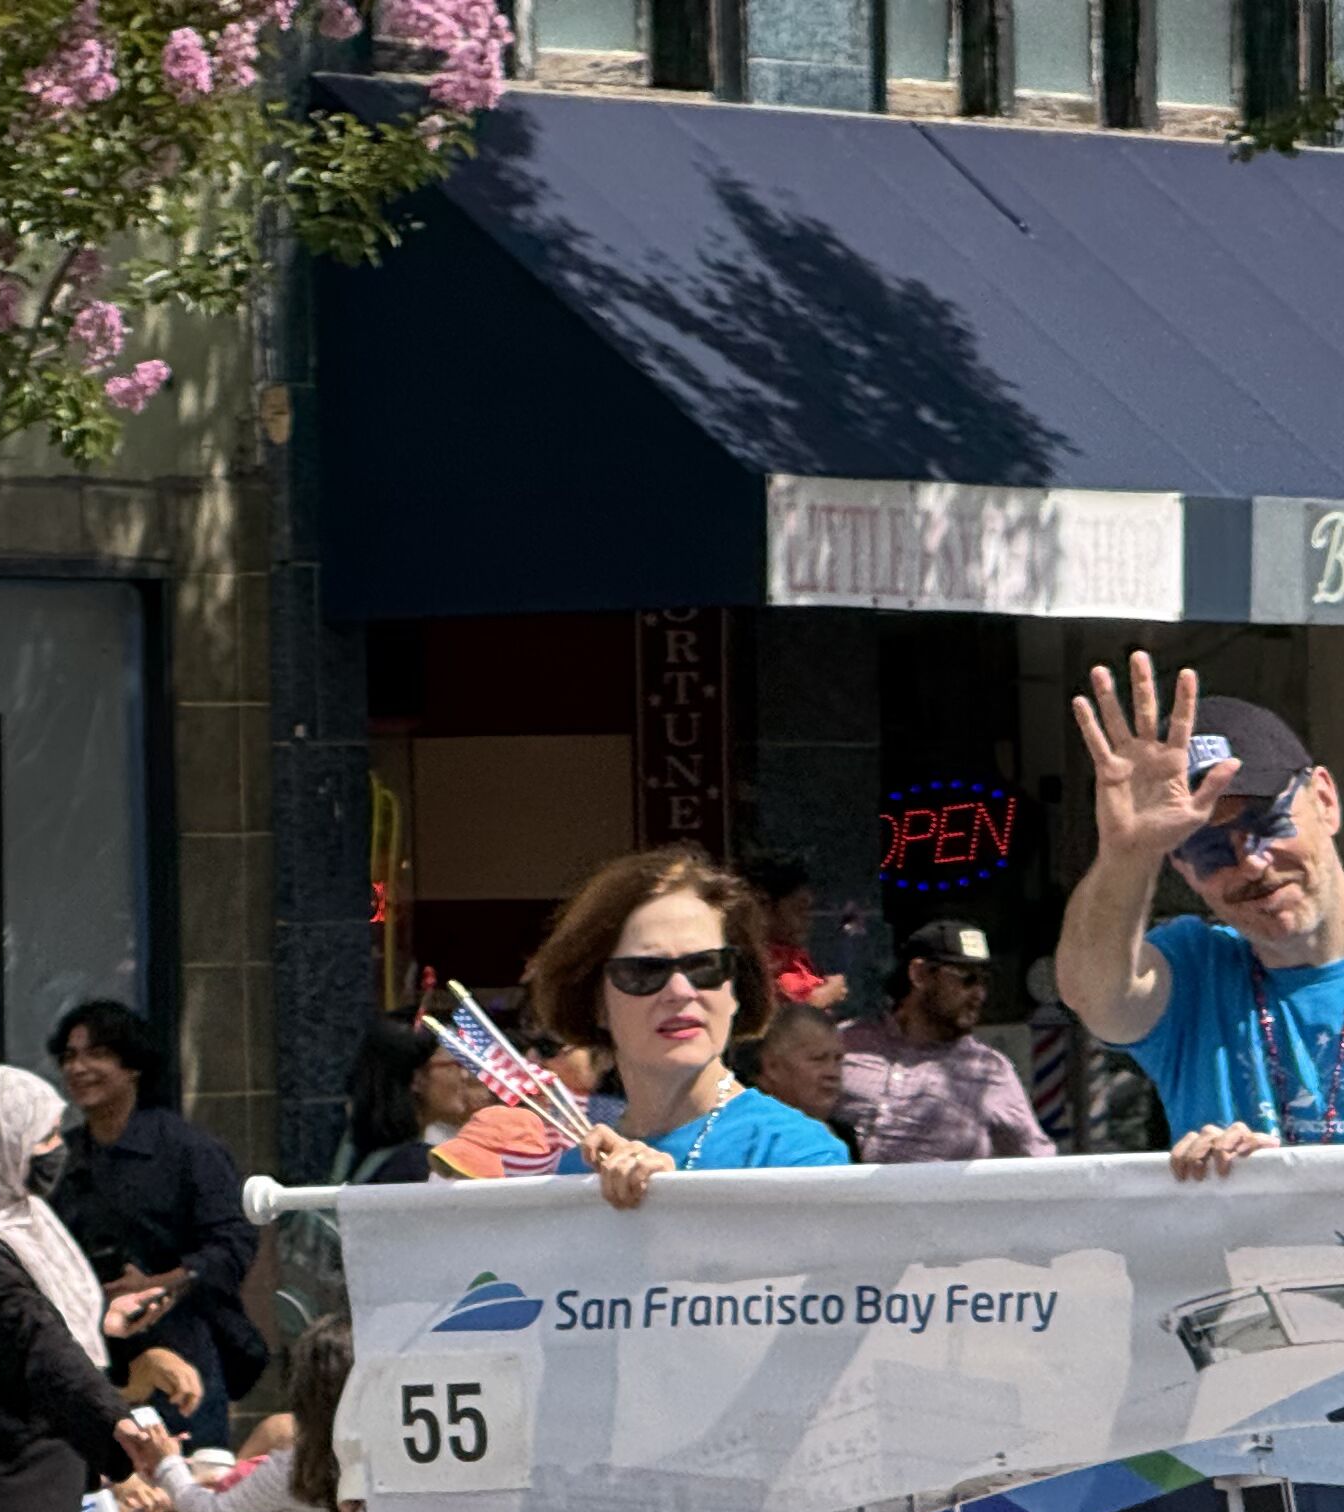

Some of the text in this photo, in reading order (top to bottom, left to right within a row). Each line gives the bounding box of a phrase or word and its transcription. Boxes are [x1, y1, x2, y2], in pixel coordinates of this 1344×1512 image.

[662, 607, 704, 831] RTUNE
[555, 1284, 1059, 1334] San Francisco Bay Ferry
[400, 1382, 488, 1464] 55
